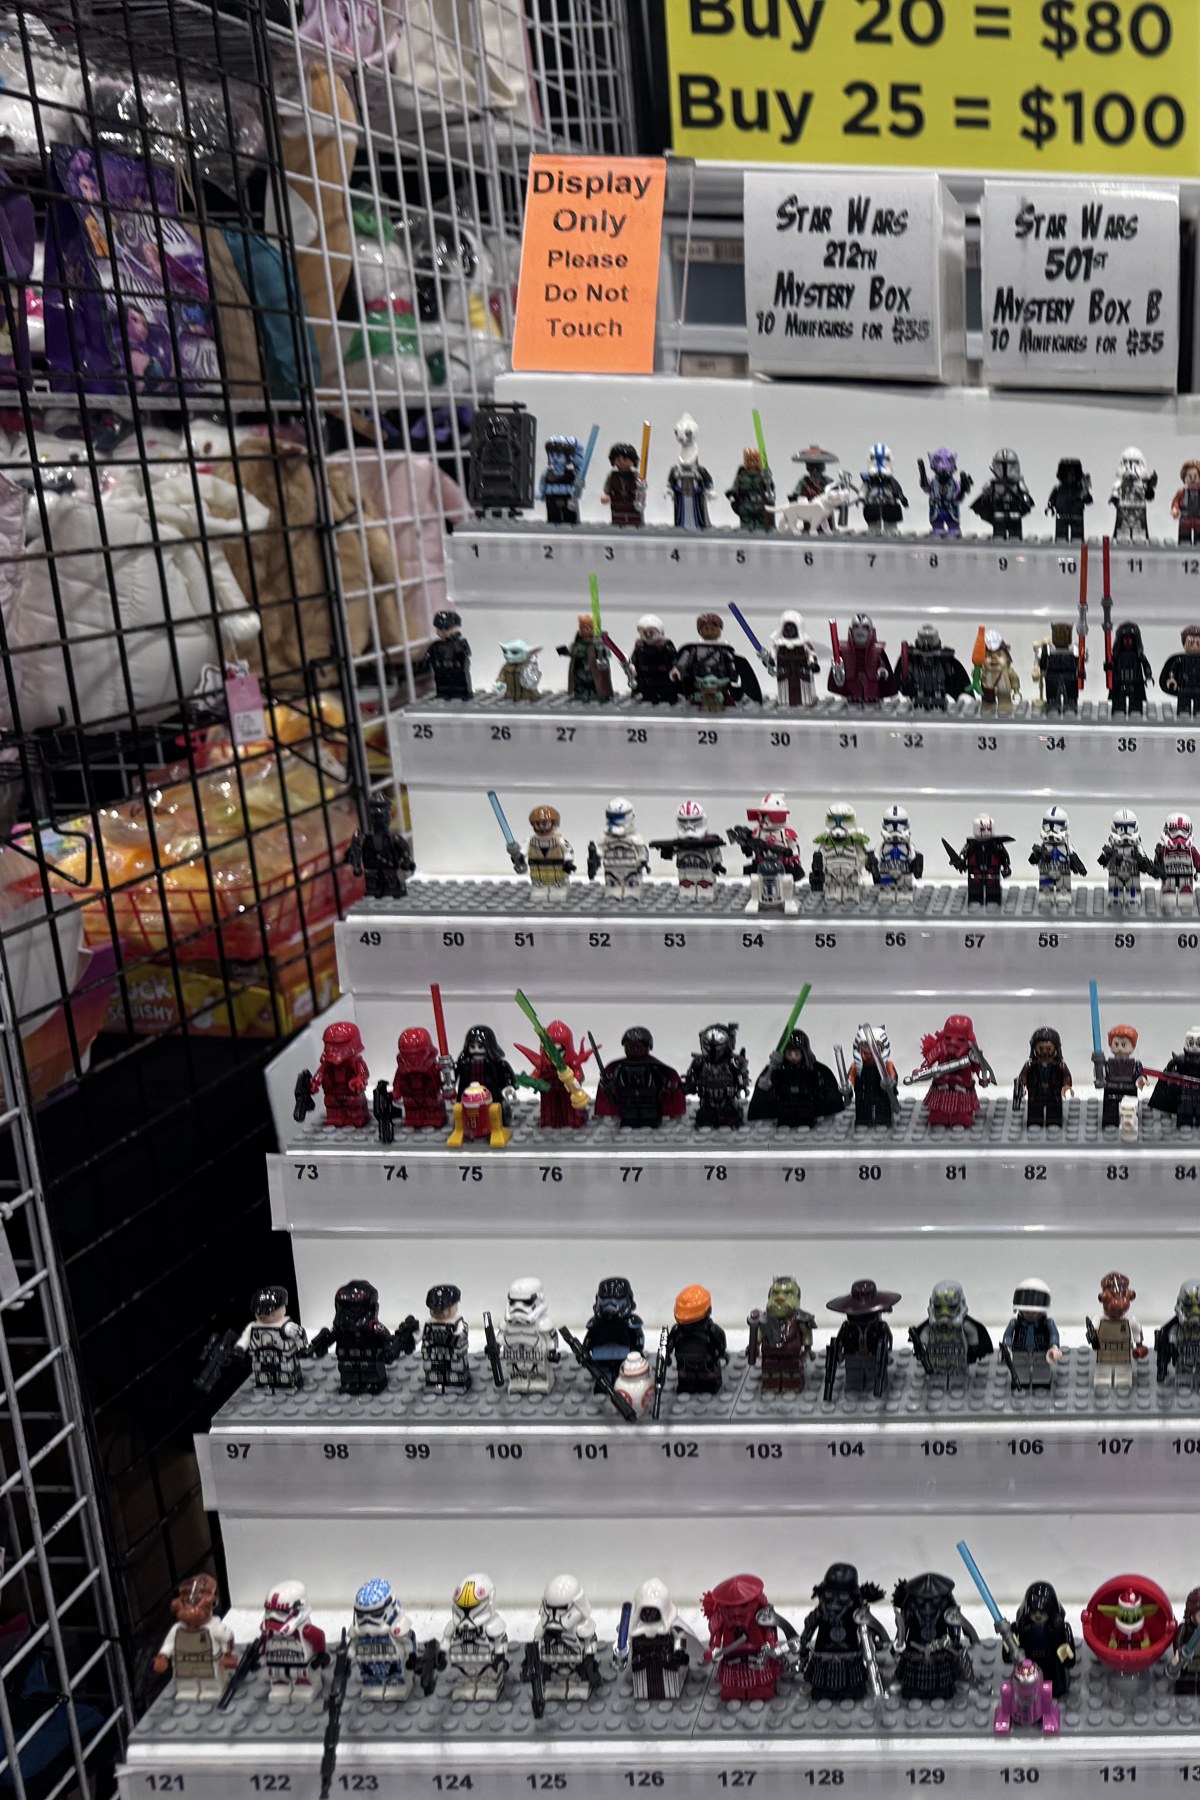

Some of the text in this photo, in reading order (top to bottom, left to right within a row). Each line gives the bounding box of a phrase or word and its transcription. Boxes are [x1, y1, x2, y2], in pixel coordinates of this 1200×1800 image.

[690, 0, 824, 52] Buy
[855, 0, 945, 47] 20
[1040, 0, 1172, 60] $80
[678, 73, 814, 145] Buy
[842, 81, 925, 138] 25
[1020, 84, 1185, 151] $100
[533, 170, 651, 200] Display
[553, 208, 627, 238] Only
[548, 249, 628, 269] Please
[545, 283, 629, 302] Do Not
[1146, 288, 1163, 326] B
[546, 317, 623, 338] Touch
[756, 310, 776, 335] 10
[892, 315, 930, 345] $35
[990, 327, 1010, 352] 10
[1126, 327, 1165, 357] $35
[543, 544, 554, 560] 2
[670, 548, 681, 563] 4
[736, 549, 746, 565] 5
[867, 553, 877, 568] 7
[998, 557, 1008, 572] 9
[1181, 559, 1200, 575] 12
[412, 723, 434, 740] 25
[490, 725, 512, 741] 26
[626, 728, 648, 744] 28
[697, 730, 719, 745] 29
[839, 733, 858, 749] 31
[977, 735, 998, 751] 33
[1046, 736, 1067, 752] 34
[1176, 738, 1196, 754] 36
[359, 930, 382, 947] 49
[442, 931, 465, 947] 50
[588, 932, 612, 948] 52
[663, 932, 687, 948] 53
[814, 933, 837, 949] 55
[964, 933, 986, 949] 57
[1038, 932, 1059, 949] 58
[1177, 933, 1199, 949] 60
[293, 1163, 319, 1181] 73
[383, 1164, 409, 1182] 74
[538, 1165, 563, 1183] 76
[619, 1166, 644, 1183] 77
[781, 1166, 806, 1183] 79
[945, 1164, 967, 1181] 81
[1024, 1164, 1047, 1181] 82
[1174, 1164, 1198, 1181] 84
[226, 1442, 252, 1460] 97
[323, 1443, 350, 1460] 98
[485, 1443, 523, 1460] 100
[572, 1443, 609, 1460] 101
[745, 1443, 783, 1460] 103
[920, 1440, 958, 1457] 105
[1007, 1438, 1044, 1456] 106
[145, 1773, 185, 1792] 121
[249, 1773, 292, 1792] 122
[432, 1773, 474, 1791] 124
[526, 1772, 568, 1790] 125
[717, 1769, 758, 1788] 127
[905, 1767, 946, 1785] 129
[999, 1767, 1040, 1785] 130
